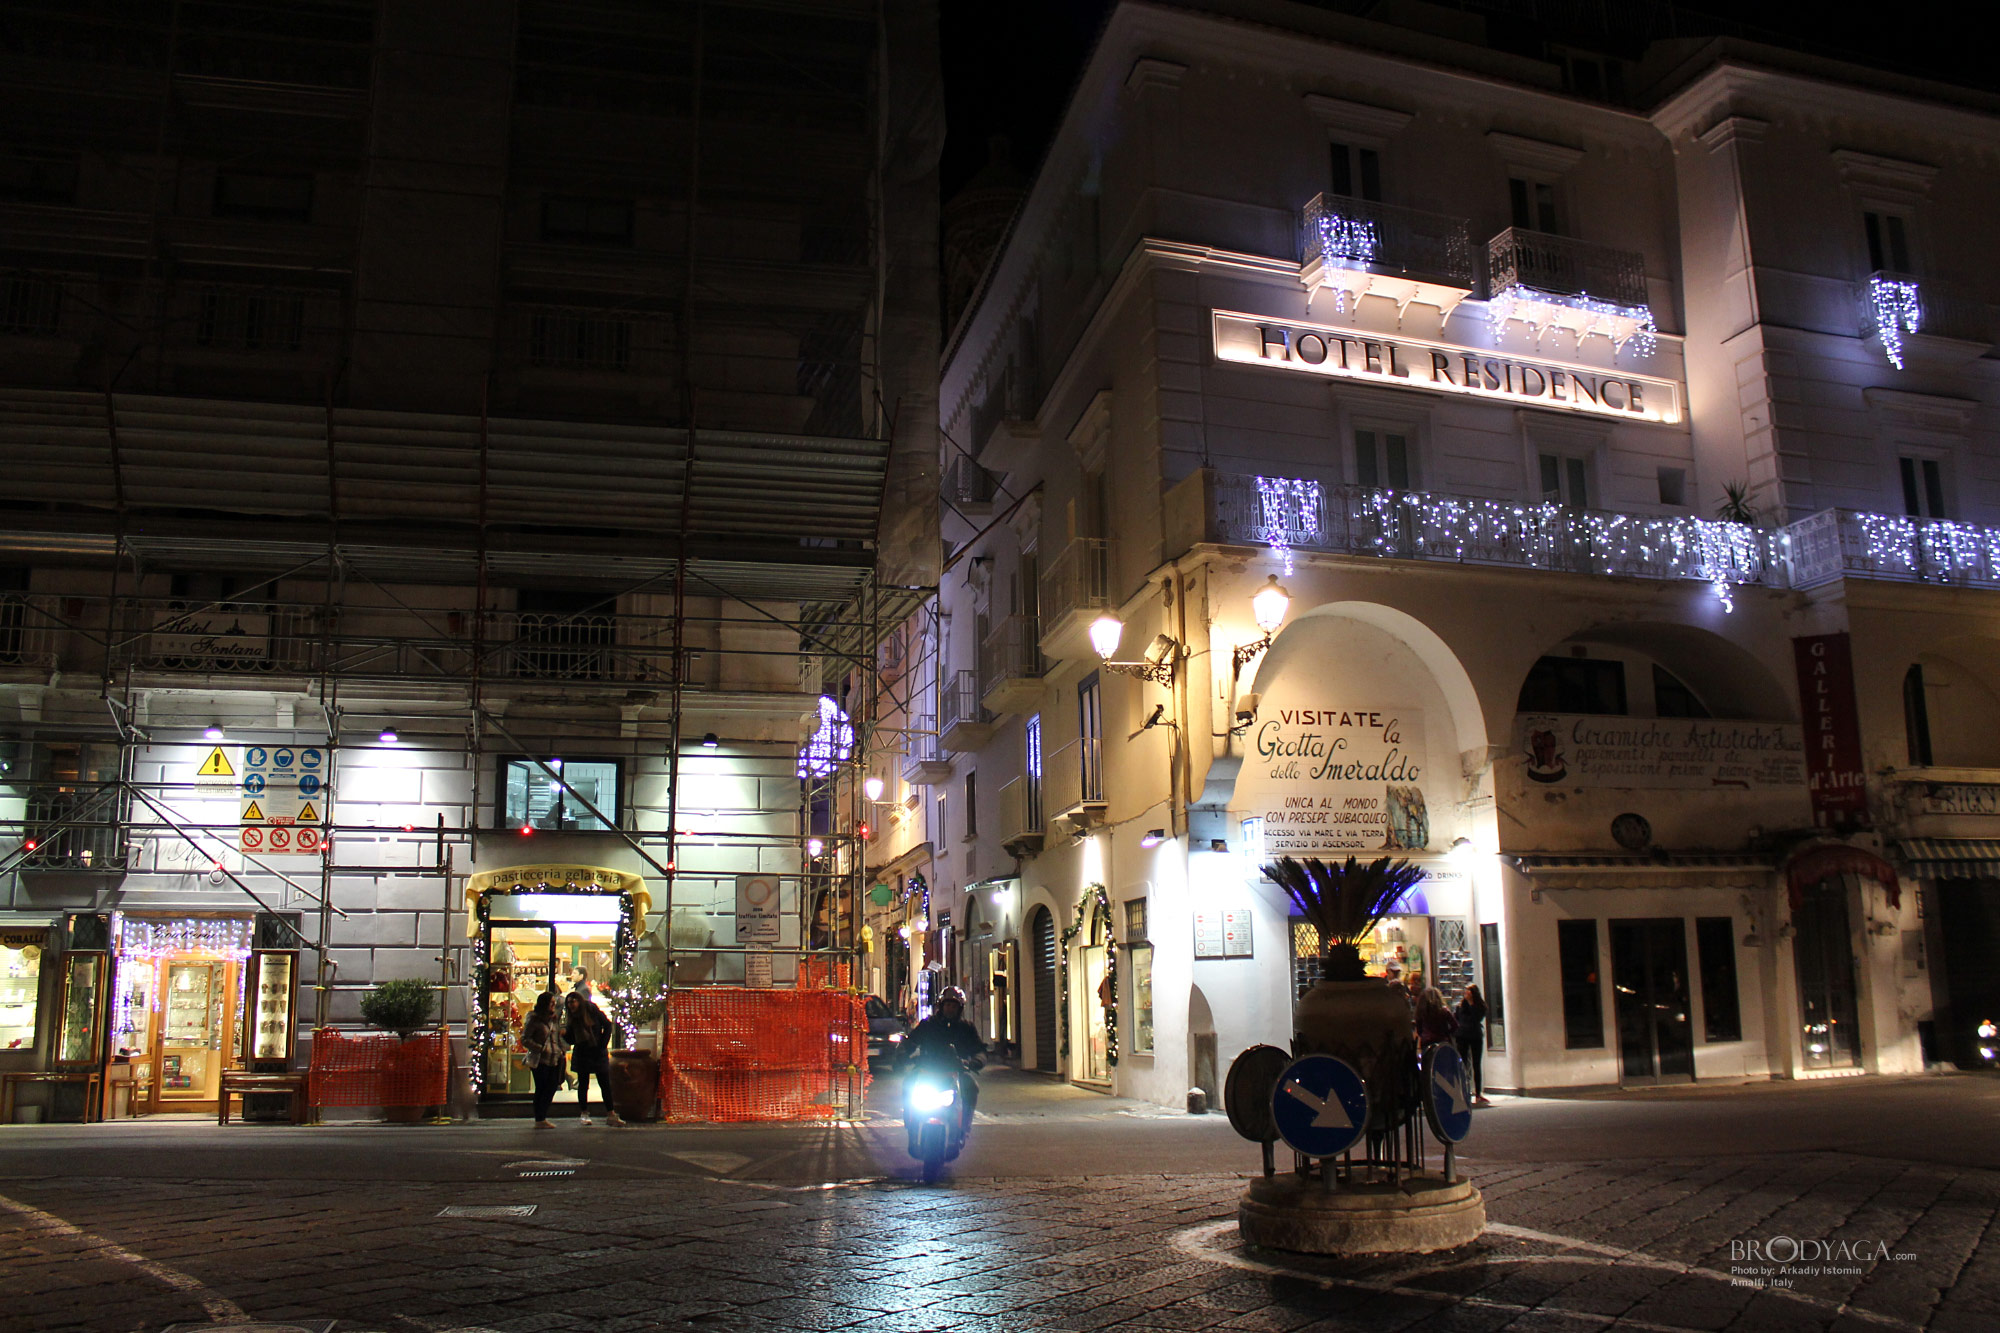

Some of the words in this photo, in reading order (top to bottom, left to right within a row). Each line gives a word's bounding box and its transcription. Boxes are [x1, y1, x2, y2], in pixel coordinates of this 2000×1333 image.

[1256, 325, 1409, 377] HOTEL
[1429, 351, 1645, 413] RESIDENCE
[191, 637, 263, 655] Fontana
[1280, 710, 1383, 727] VISITATE
[1383, 718, 1401, 744] la
[1572, 719, 1671, 748] Ceramiche
[1684, 722, 1771, 749] Artistiche
[1257, 720, 1325, 763] Grotta
[1270, 761, 1301, 779] dello
[1310, 738, 1421, 782] Smeraldo
[1285, 797, 1313, 809] UNICA
[1320, 798, 1333, 809] AL
[1343, 798, 1378, 809] MONDO
[1265, 811, 1286, 823] CON
[1288, 812, 1330, 824] PRESEPE
[1333, 812, 1388, 824] SUBACQUEO
[1264, 829, 1295, 837] ACCESSO
[1300, 829, 1311, 837] VIA
[1314, 829, 1334, 837] MARE
[1275, 840, 1308, 848] SERVIZIO
[1312, 840, 1319, 848] DI
[1322, 840, 1365, 848] ASCENSORE
[493, 869, 561, 886] pasticceria
[565, 869, 620, 885] gelateria
[4, 934, 43, 944] CORALLI
